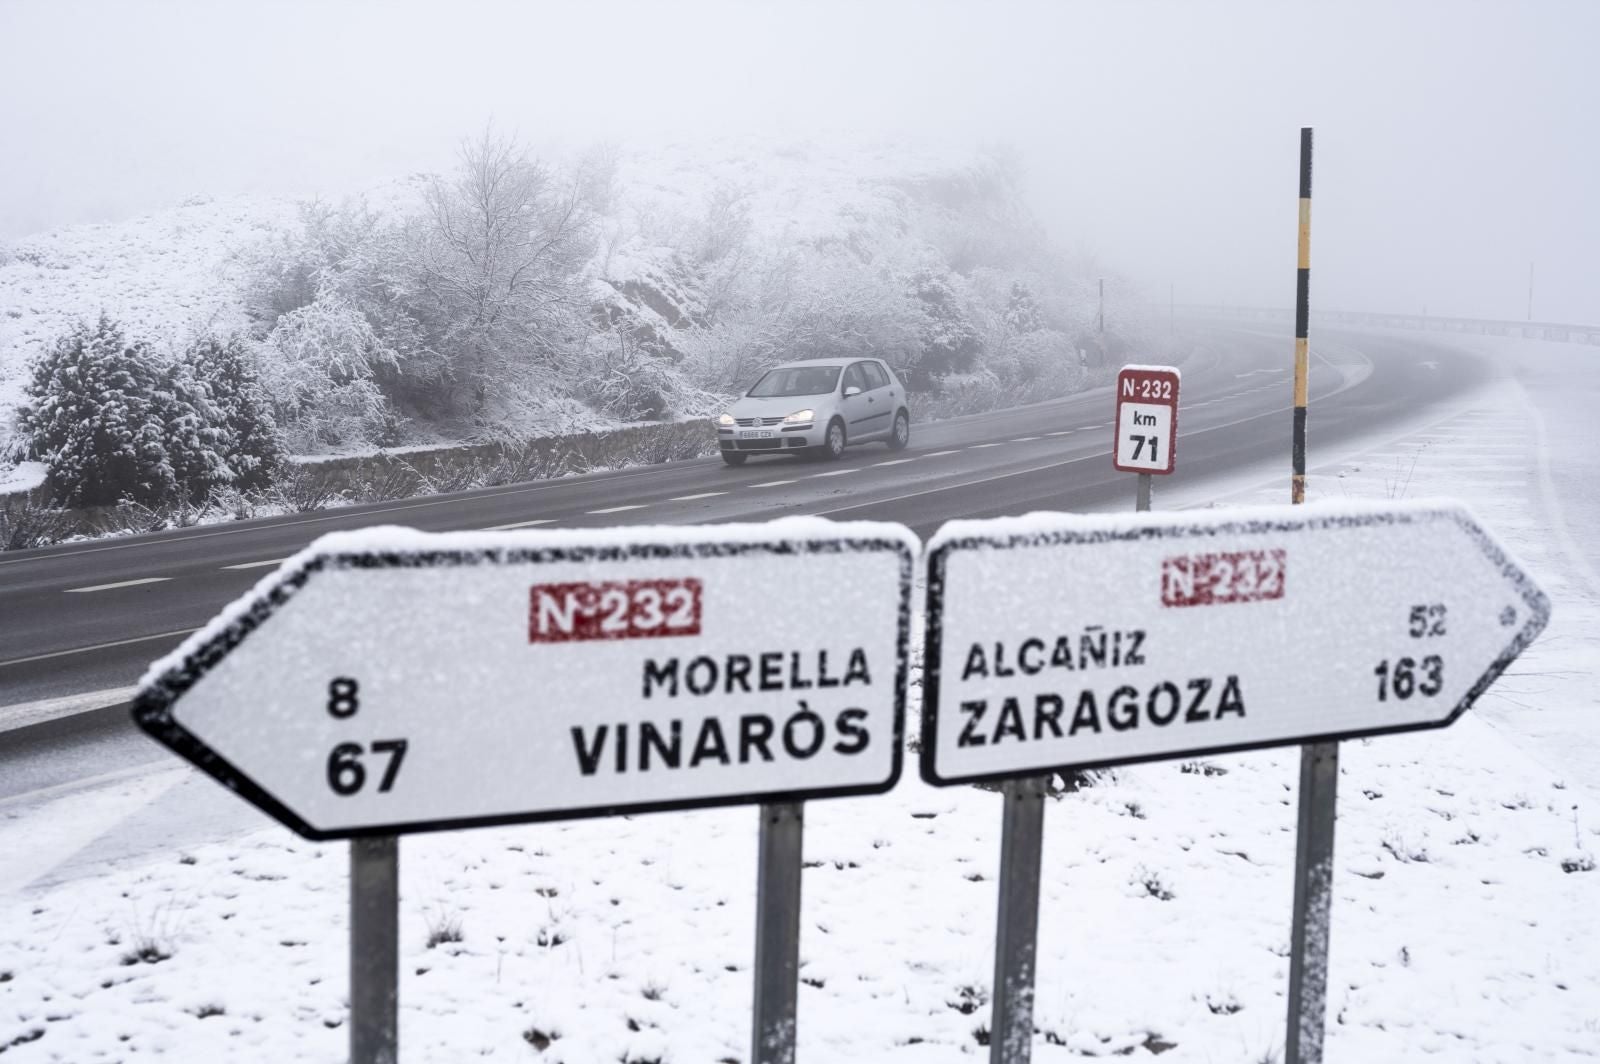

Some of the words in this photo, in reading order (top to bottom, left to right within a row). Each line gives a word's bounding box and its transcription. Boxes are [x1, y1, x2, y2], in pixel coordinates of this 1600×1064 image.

[1122, 377, 1172, 399] N-232
[1133, 410, 1157, 426] km
[1129, 434, 1158, 462] 71
[1166, 558, 1280, 601] N-232
[961, 625, 1147, 681] ALCAÑIZ
[1408, 603, 1447, 638] 52
[326, 675, 360, 720] 8
[642, 647, 871, 698] MORELLA
[957, 675, 1247, 748] ZARAGOZA
[1374, 655, 1444, 702] 163
[326, 738, 409, 797] 67
[570, 699, 871, 776] VINARÒS
